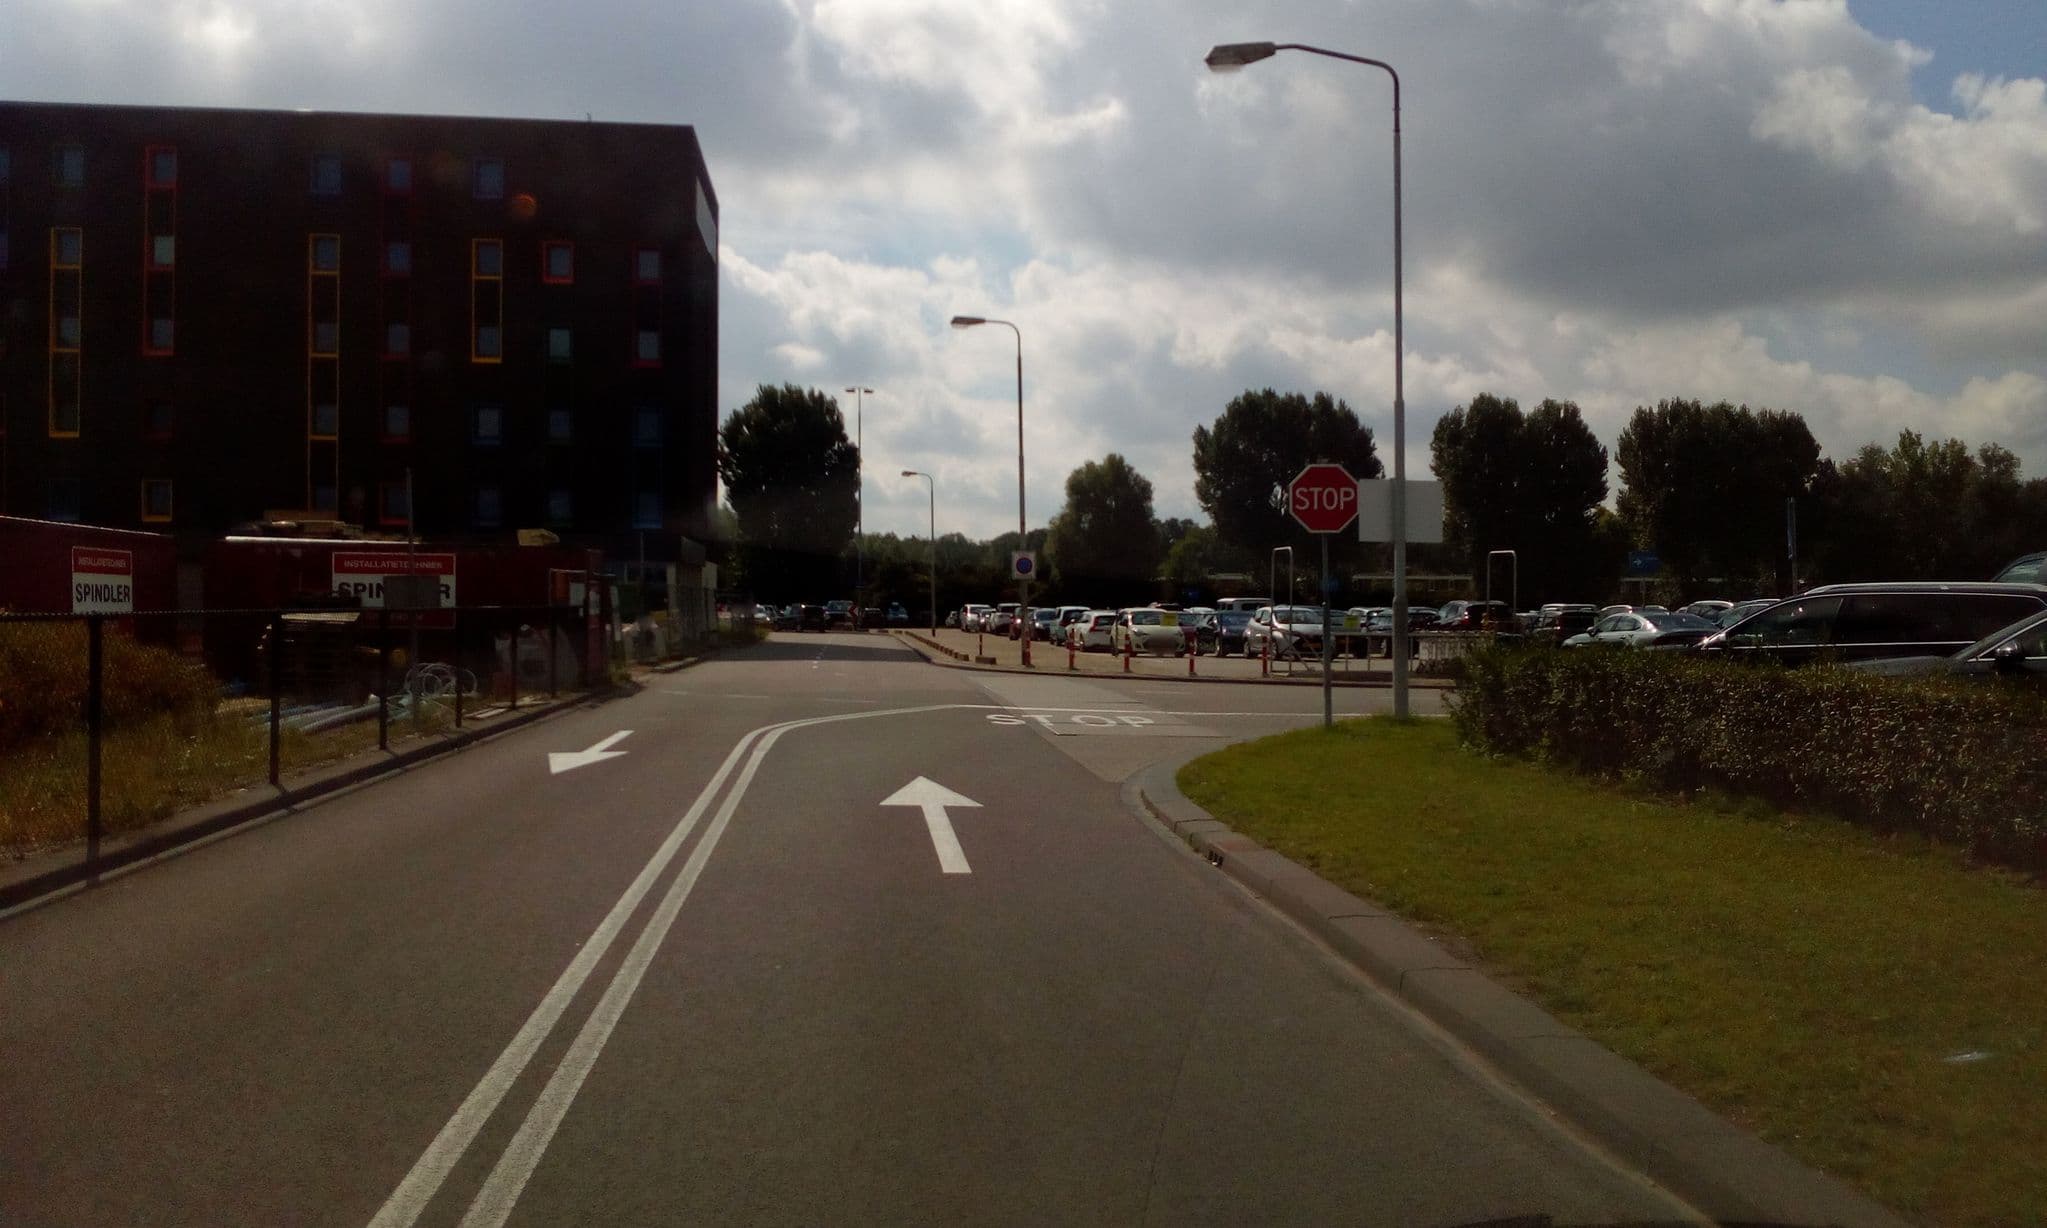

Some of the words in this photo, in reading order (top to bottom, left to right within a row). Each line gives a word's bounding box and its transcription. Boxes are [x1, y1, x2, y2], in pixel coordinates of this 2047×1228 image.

[1295, 487, 1355, 510] STOP
[75, 583, 130, 602] SPINDLER
[339, 582, 450, 599] SPINR
[985, 714, 1155, 729] STOP
